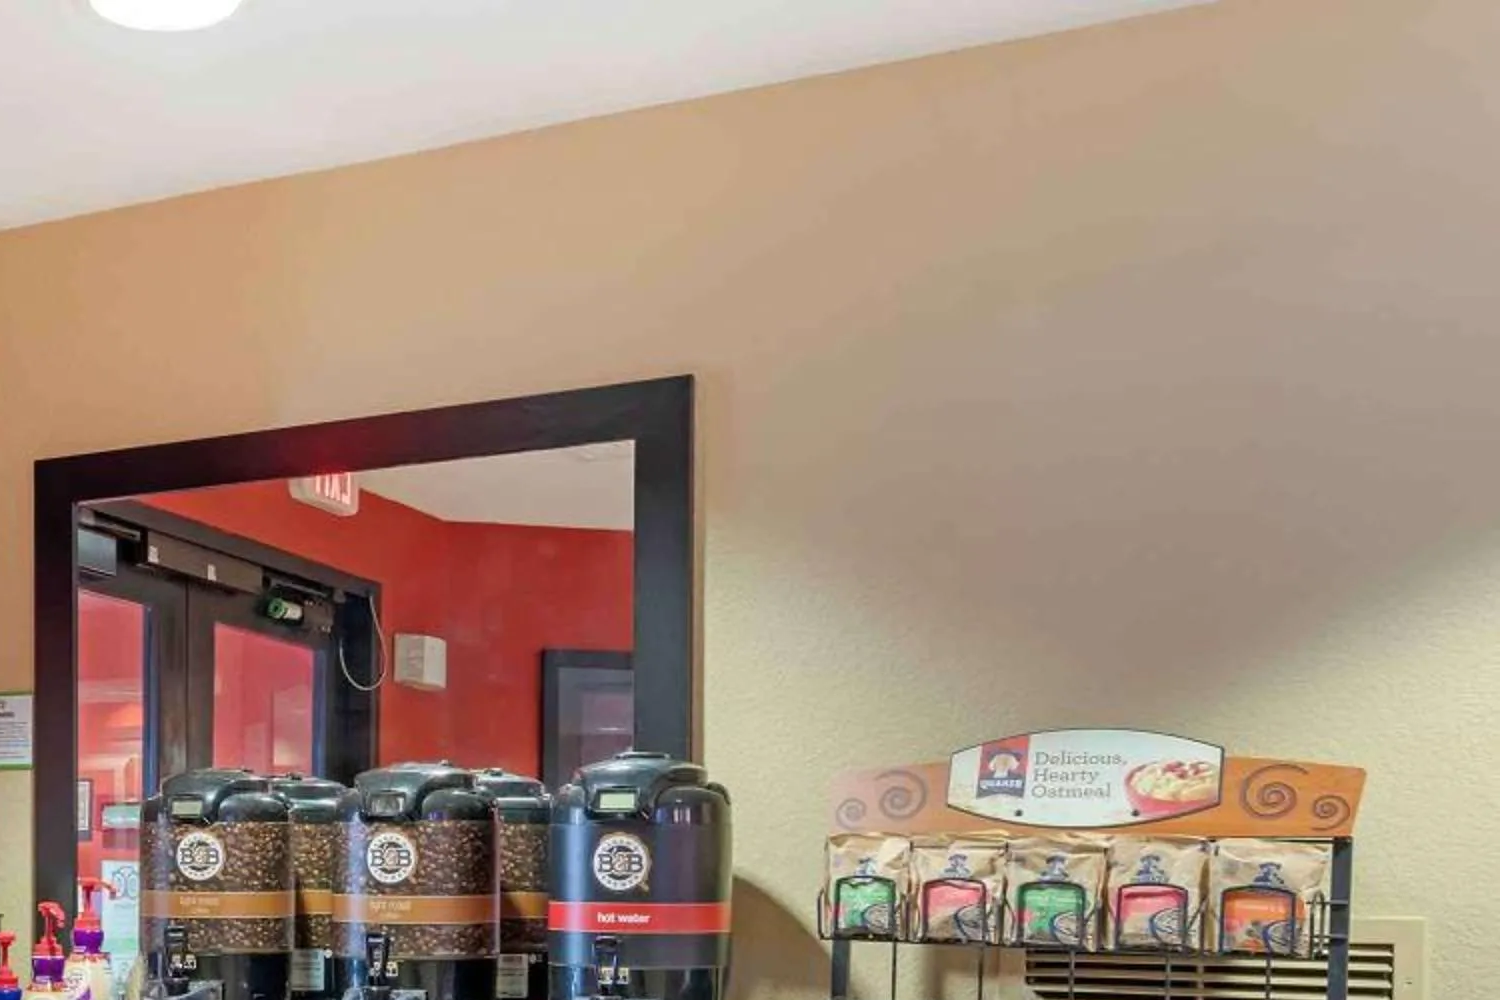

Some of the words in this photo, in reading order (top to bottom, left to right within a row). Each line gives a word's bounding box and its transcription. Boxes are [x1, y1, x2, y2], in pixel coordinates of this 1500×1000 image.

[1033, 767, 1100, 783] Hearty
[1031, 783, 1111, 799] Oatmeal
[597, 911, 615, 923] hot
[618, 913, 650, 924] water
